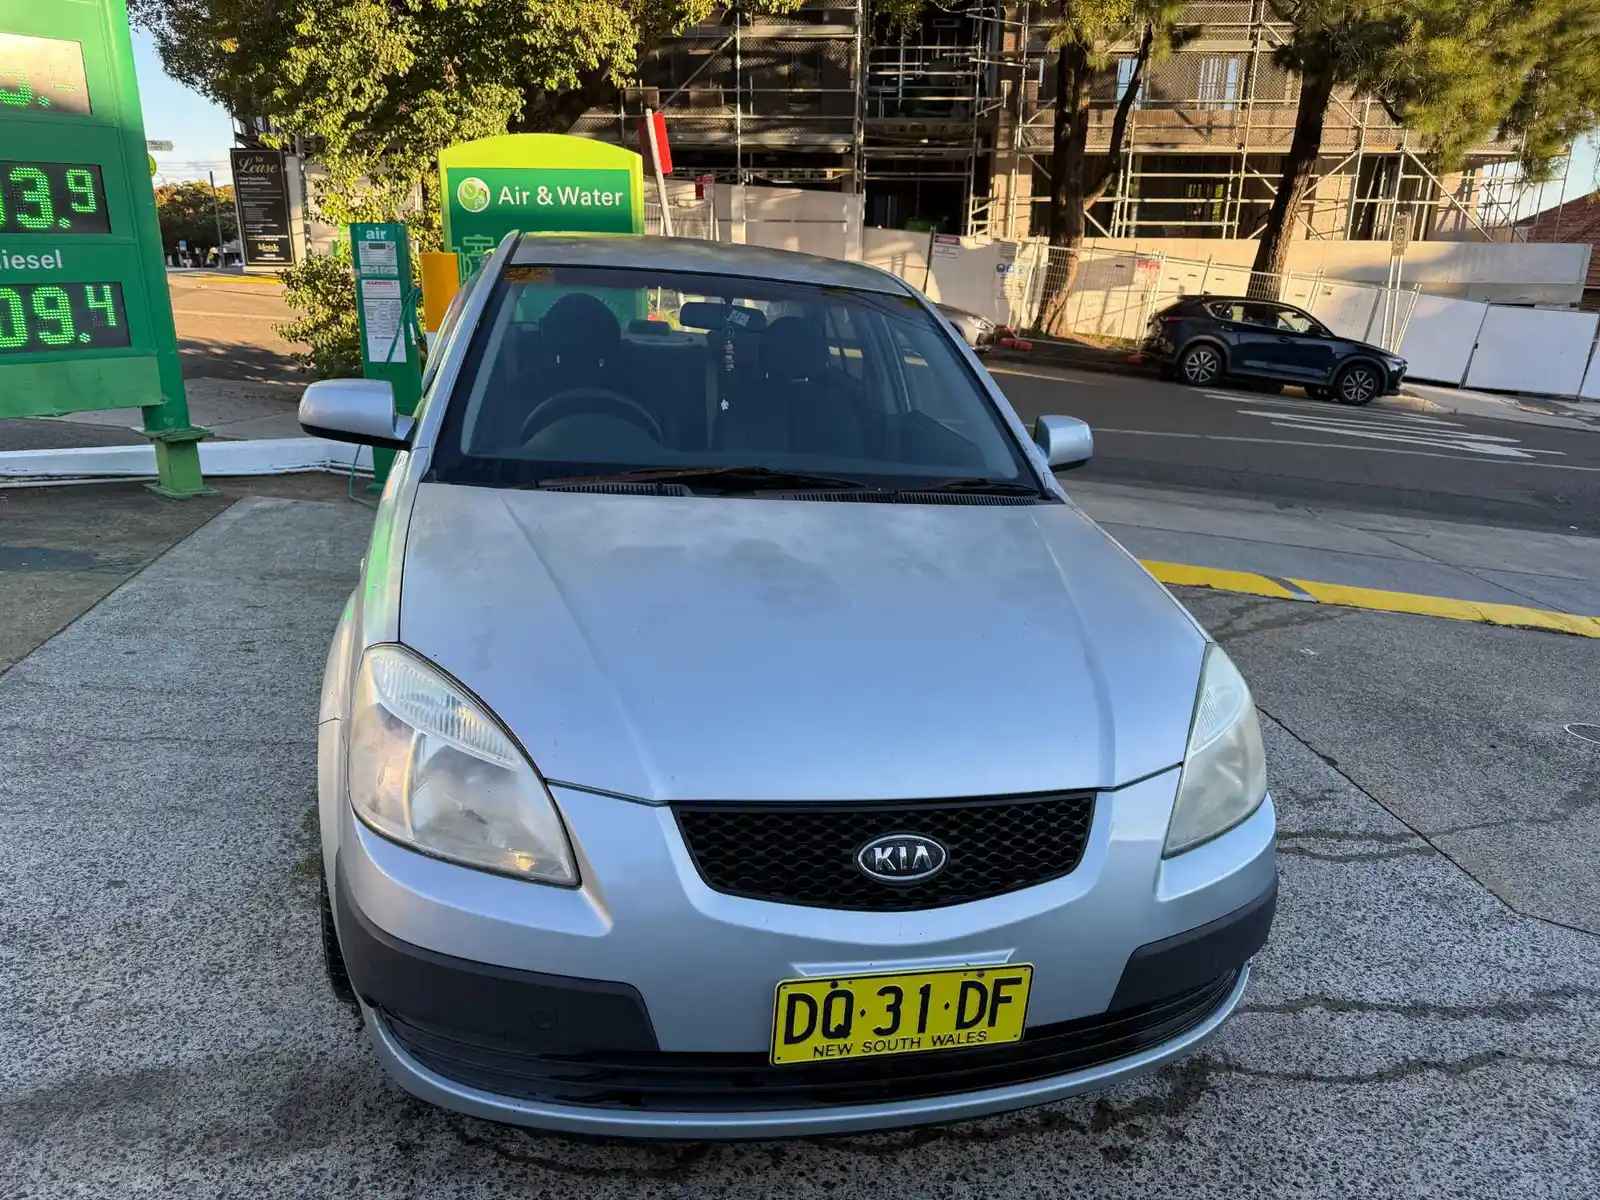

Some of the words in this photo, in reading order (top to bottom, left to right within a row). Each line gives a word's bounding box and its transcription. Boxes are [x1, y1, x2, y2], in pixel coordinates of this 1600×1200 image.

[237, 157, 278, 173] Lease
[0, 166, 97, 229] 3.9
[498, 186, 530, 206] Air
[536, 186, 554, 206] &
[556, 186, 623, 207] Water
[365, 227, 387, 240] air
[0, 249, 63, 270] iesel
[873, 845, 933, 870] KIA
[812, 1043, 855, 1058] NEW
[862, 1037, 921, 1053] SOUTH
[931, 1030, 988, 1046] WALES
